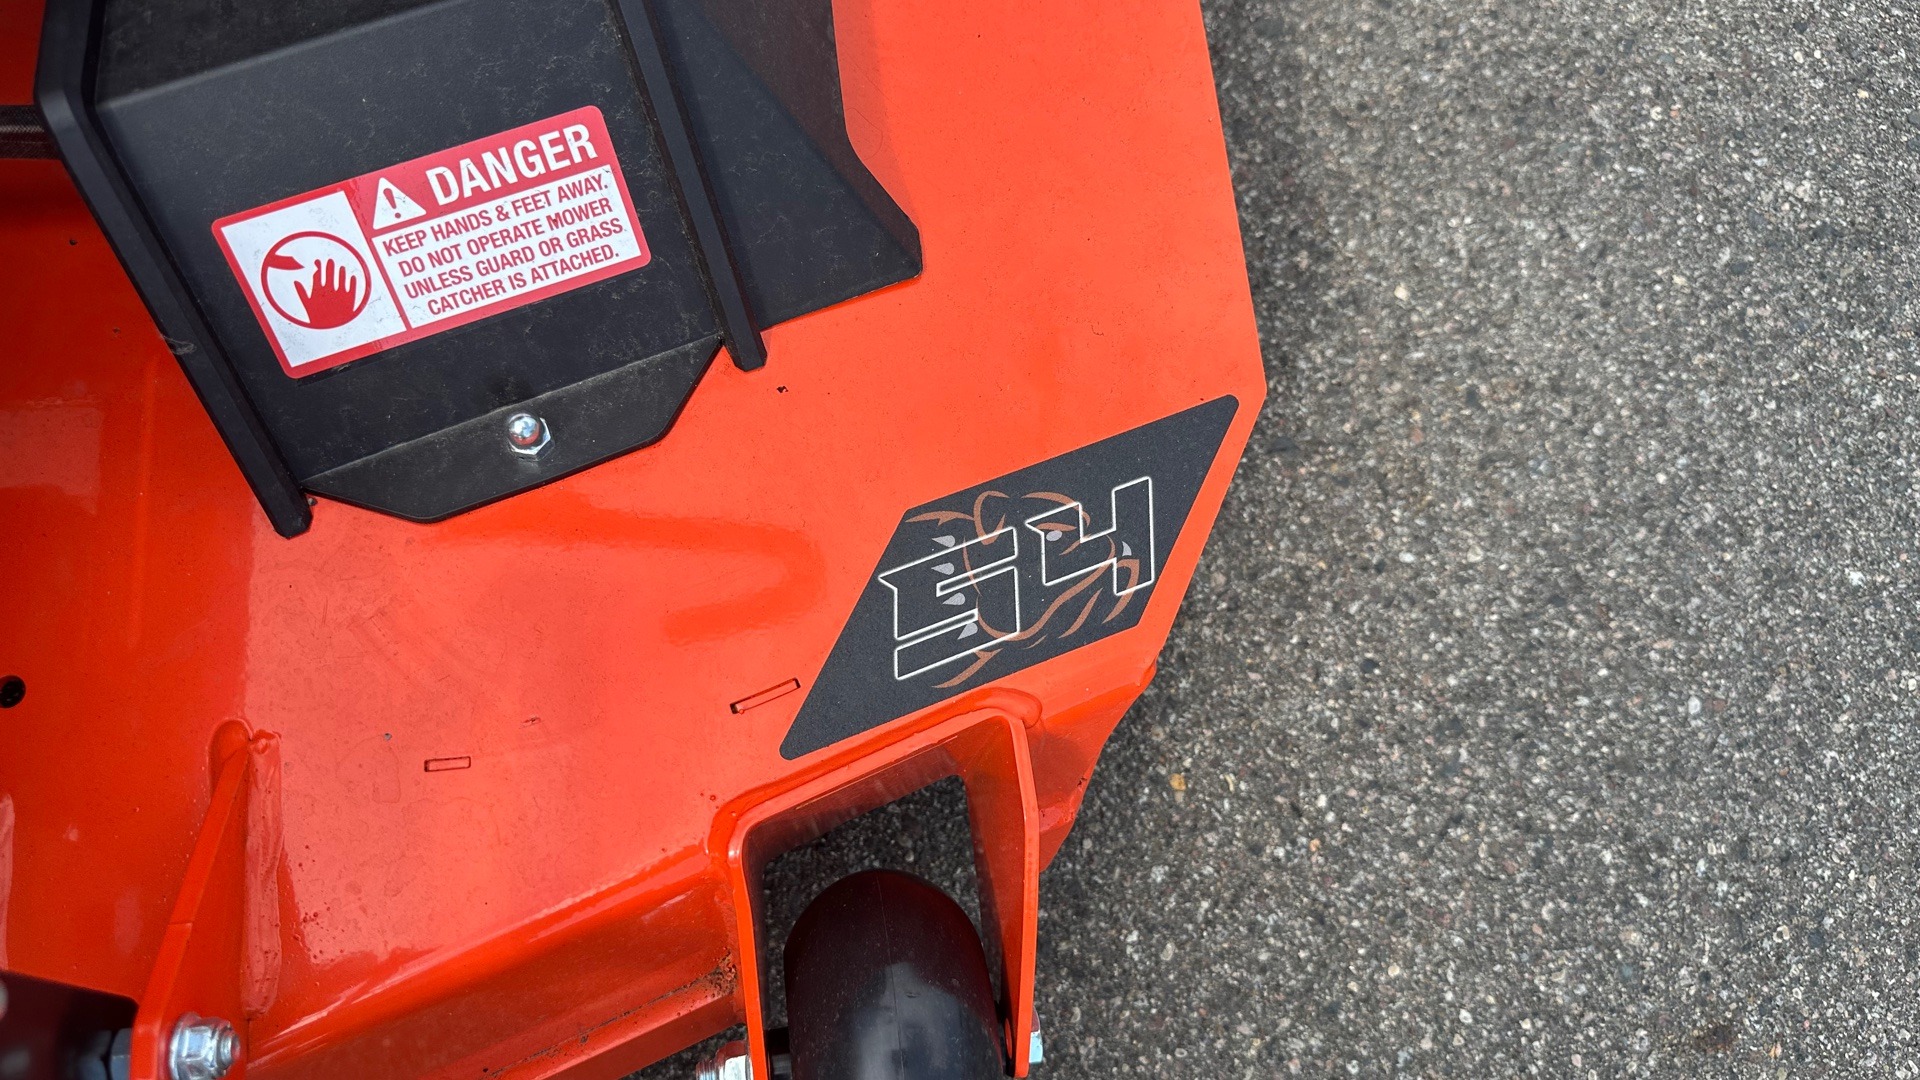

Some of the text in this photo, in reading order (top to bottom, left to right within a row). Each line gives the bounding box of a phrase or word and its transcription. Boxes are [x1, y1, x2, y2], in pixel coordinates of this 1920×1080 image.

[425, 123, 598, 206] DANGER
[382, 173, 608, 256] KEEP HANDS & FEET AWAY.
[398, 197, 613, 277] DO NOT OPERATE MOWER
[404, 217, 623, 299] UNLESS GUARD OR GRASS
[427, 244, 619, 315] CATCHER IS ATTACHED.
